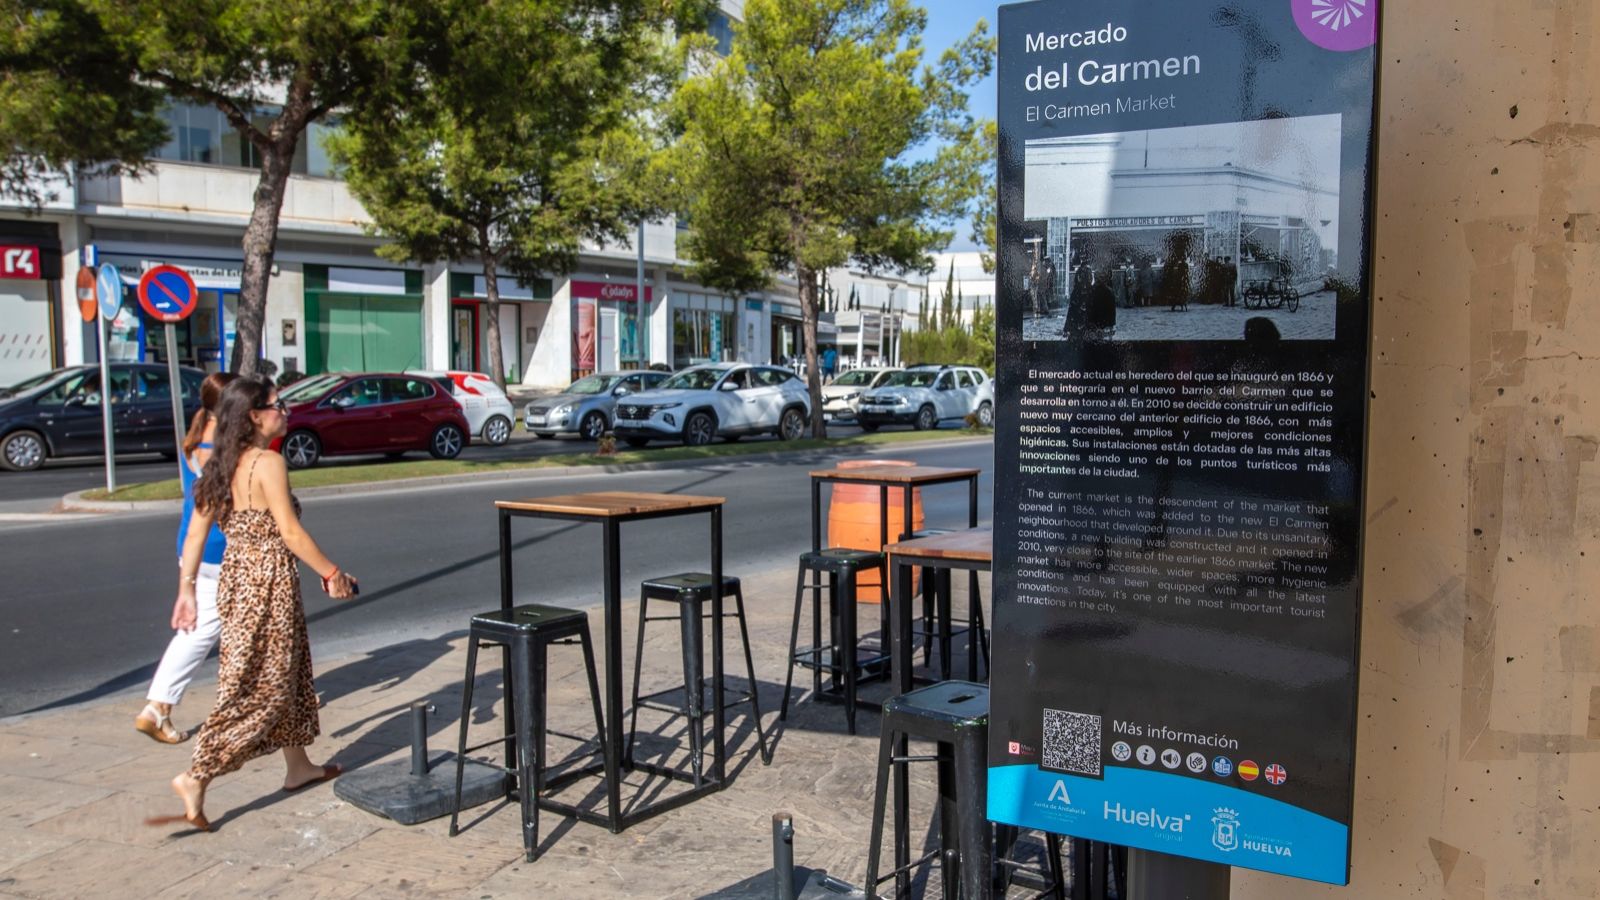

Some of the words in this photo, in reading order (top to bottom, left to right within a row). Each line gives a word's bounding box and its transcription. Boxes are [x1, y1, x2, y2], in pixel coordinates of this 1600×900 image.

[1025, 22, 1127, 53] Mercado
[1025, 62, 1068, 92] del
[1078, 54, 1200, 86] Carmen
[1026, 106, 1039, 122] El
[1044, 101, 1111, 119] Carmen
[1116, 93, 1176, 113] Market
[1028, 369, 1037, 378] El
[1038, 369, 1081, 379] mercado
[1082, 370, 1113, 379] actual
[1128, 370, 1174, 380] heredero
[1176, 370, 1192, 380] del
[1194, 372, 1214, 382] que
[1216, 372, 1228, 380] se
[1230, 371, 1278, 383] inauguró
[1280, 373, 1294, 381] en
[1297, 371, 1324, 381] 1866
[1326, 373, 1334, 384] y
[1020, 384, 1038, 394] que
[1043, 384, 1054, 392] se
[1059, 383, 1105, 395] integraría
[1111, 385, 1124, 393] en
[1129, 384, 1138, 393] el
[1144, 386, 1175, 394] nuevo
[1182, 384, 1212, 394] barrio
[1219, 385, 1235, 395] del
[1241, 385, 1285, 396] Carmen
[1291, 388, 1313, 398] que
[1320, 388, 1333, 396] se
[1020, 396, 1066, 406] desarrolla
[1082, 397, 1108, 407] torno
[1109, 399, 1115, 407] a
[1117, 398, 1128, 407] él.
[1131, 398, 1143, 408] En
[1145, 398, 1170, 408] 2010
[1172, 400, 1184, 408] se
[1186, 399, 1221, 409] decide
[1223, 400, 1272, 410] construir
[1274, 402, 1288, 410] un
[1290, 401, 1333, 411] edificio
[1020, 411, 1048, 419] nuevo
[1051, 412, 1072, 422] muy
[1076, 413, 1116, 421] cercano
[1119, 412, 1135, 421] del
[1139, 412, 1179, 422] anterior
[1183, 413, 1222, 424] edificio
[1226, 414, 1240, 424] de
[1244, 415, 1273, 426] 1866,
[1278, 417, 1299, 426] con
[1308, 416, 1332, 426] más
[1019, 423, 1060, 435] espacios
[1070, 425, 1123, 436] accesibles,
[1133, 426, 1172, 439] amplios
[1183, 429, 1189, 439] y
[1210, 428, 1253, 441] mejores
[1264, 430, 1332, 441] condiciones
[1019, 436, 1068, 449] higiénicas.
[1072, 438, 1089, 448] Sus
[1093, 439, 1157, 450] instalaciones
[1160, 441, 1189, 451] están
[1192, 442, 1236, 453] dotadas
[1239, 444, 1253, 454] de
[1257, 444, 1272, 454] las
[1276, 445, 1300, 455] más
[1304, 446, 1331, 456] altas
[1019, 450, 1080, 461] innovaciones
[1088, 452, 1120, 463] siendo
[1128, 456, 1147, 464] uno
[1155, 455, 1168, 465] de
[1177, 456, 1192, 466] los
[1200, 457, 1237, 470] puntos
[1246, 458, 1297, 470] turísticos
[1307, 461, 1330, 471] más
[1019, 463, 1076, 476] importantes
[1078, 466, 1090, 475] de
[1093, 466, 1101, 476] la
[1103, 467, 1139, 477] ciudad.
[1027, 489, 1043, 499] The
[1048, 490, 1081, 501] current
[1086, 492, 1119, 503] market
[1124, 494, 1132, 504] is
[1137, 495, 1153, 505] the
[1158, 496, 1217, 508] descendent
[1223, 499, 1234, 510] of
[1240, 500, 1257, 511] the
[1262, 501, 1300, 513] market
[1306, 504, 1328, 515] that
[1018, 502, 1052, 515] opened
[1058, 504, 1066, 514] in
[1102, 507, 1130, 517] which
[1136, 510, 1155, 519] was
[1161, 510, 1193, 521] added
[1200, 512, 1211, 522] to
[1217, 513, 1234, 524] the
[1240, 516, 1262, 525] new
[1269, 516, 1278, 526] El
[1285, 517, 1329, 529] Carmen
[1018, 515, 1087, 530] neighbourhood
[1090, 519, 1109, 529] that
[1112, 521, 1163, 535] developed
[1166, 524, 1201, 535] around
[1217, 527, 1238, 538] Due
[1241, 528, 1252, 539] to
[1255, 529, 1268, 540] its
[1071, 533, 1077, 541] a
[1081, 534, 1100, 542] new
[1104, 534, 1142, 547] building
[1146, 538, 1165, 547] was
[1169, 538, 1231, 551] constructed
[1236, 542, 1255, 553] and
[1260, 544, 1266, 554] it
[1272, 545, 1313, 559] opened
[1318, 548, 1328, 558] in
[1016, 594, 1066, 607] attractions
[1068, 598, 1076, 608] in
[1079, 599, 1095, 610] the
[1132, 592, 1151, 601] one
[1157, 593, 1167, 603] of
[1174, 594, 1191, 605] the
[1197, 596, 1223, 608] most
[1230, 599, 1282, 615] important
[1290, 604, 1325, 617] tourist
[1113, 719, 1143, 736] Más
[1147, 724, 1239, 750] información
[1104, 800, 1184, 833] Huelva
[1243, 839, 1292, 857] HUELVA
